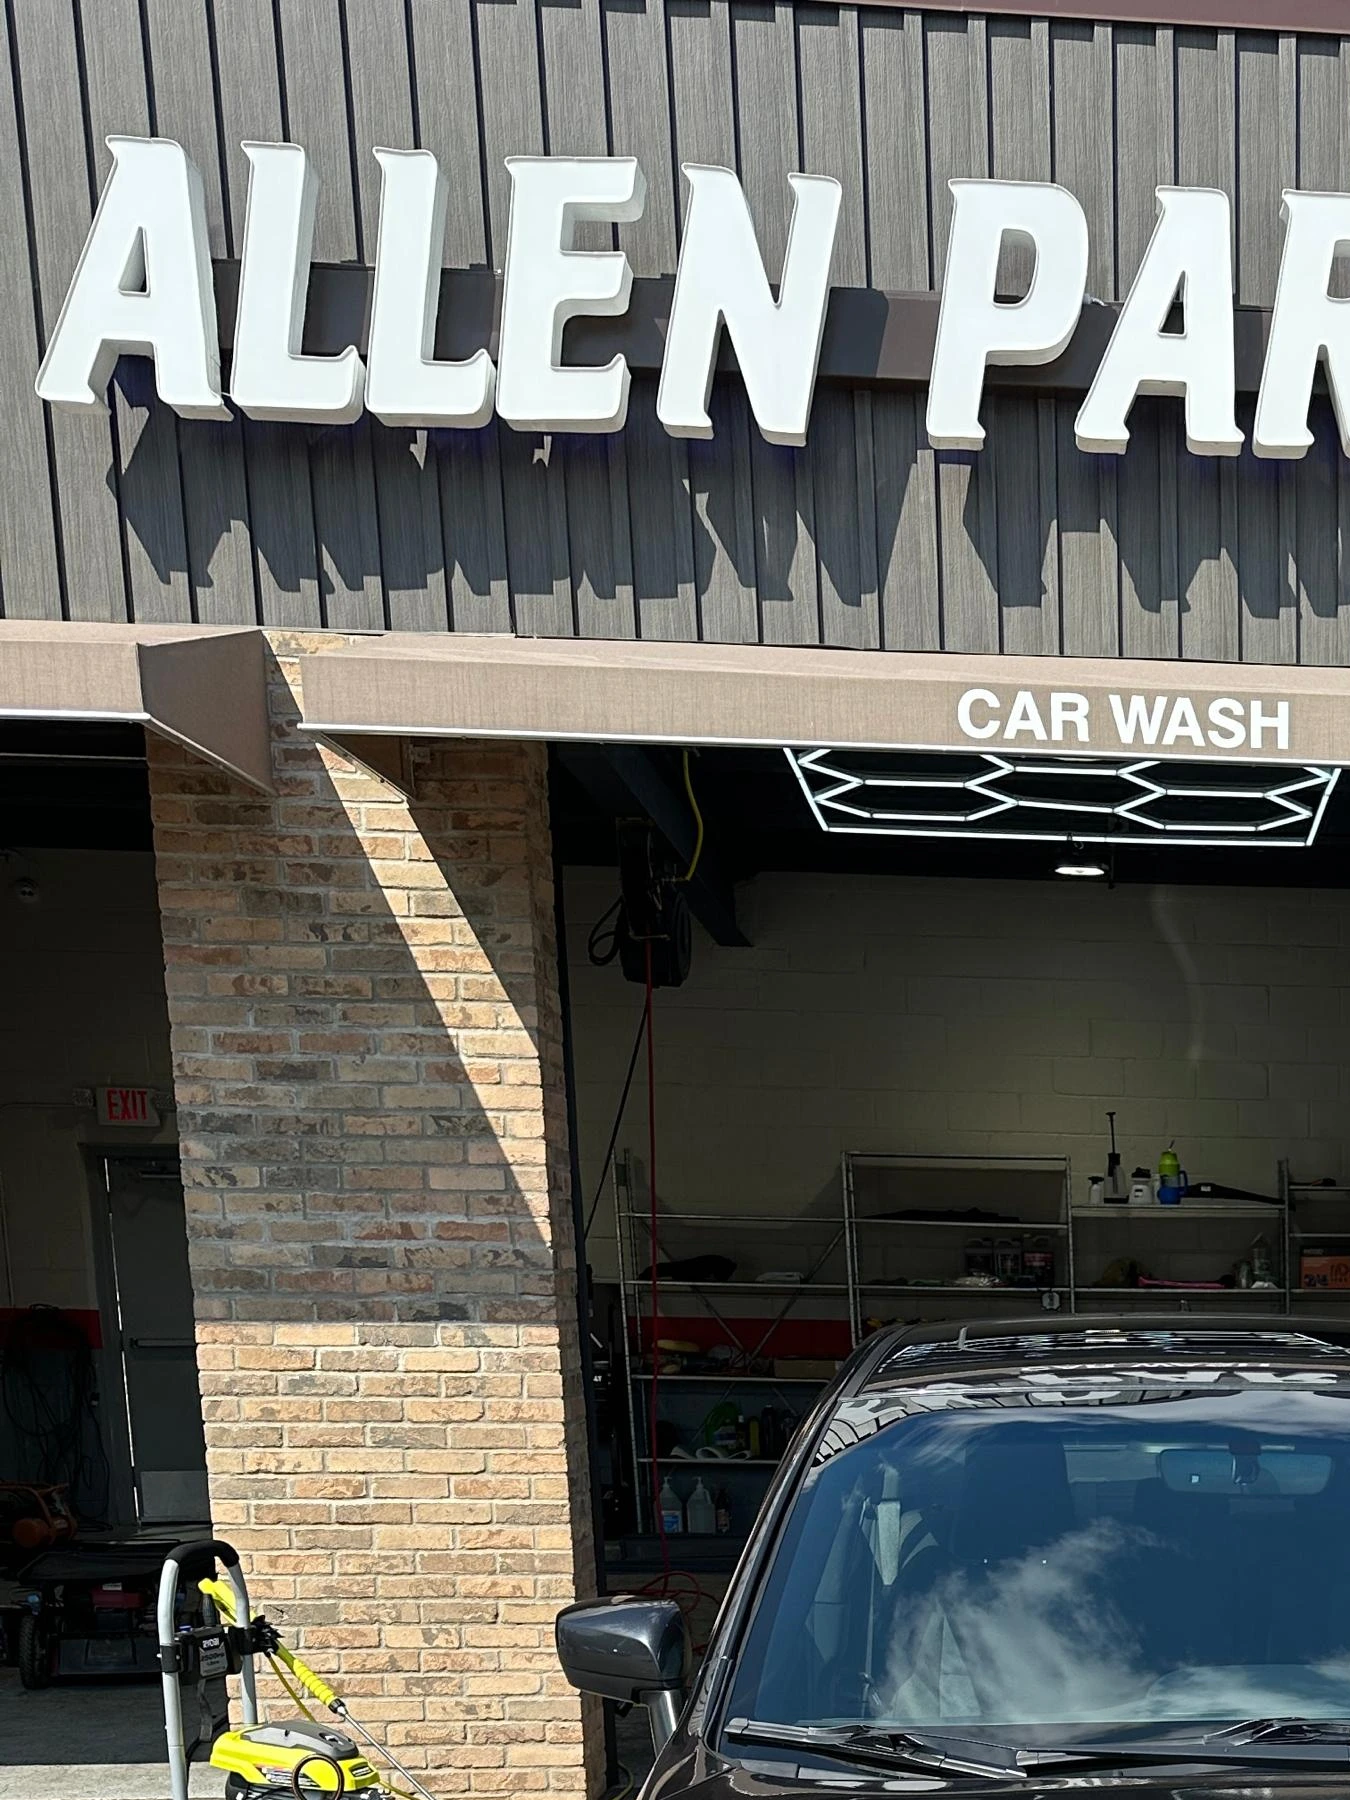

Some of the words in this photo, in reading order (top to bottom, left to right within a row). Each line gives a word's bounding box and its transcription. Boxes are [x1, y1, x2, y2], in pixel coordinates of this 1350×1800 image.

[35, 135, 844, 447] ALLEN
[957, 688, 1091, 742] CAR
[1108, 694, 1289, 750] WASH
[106, 1088, 148, 1120] EXIT
